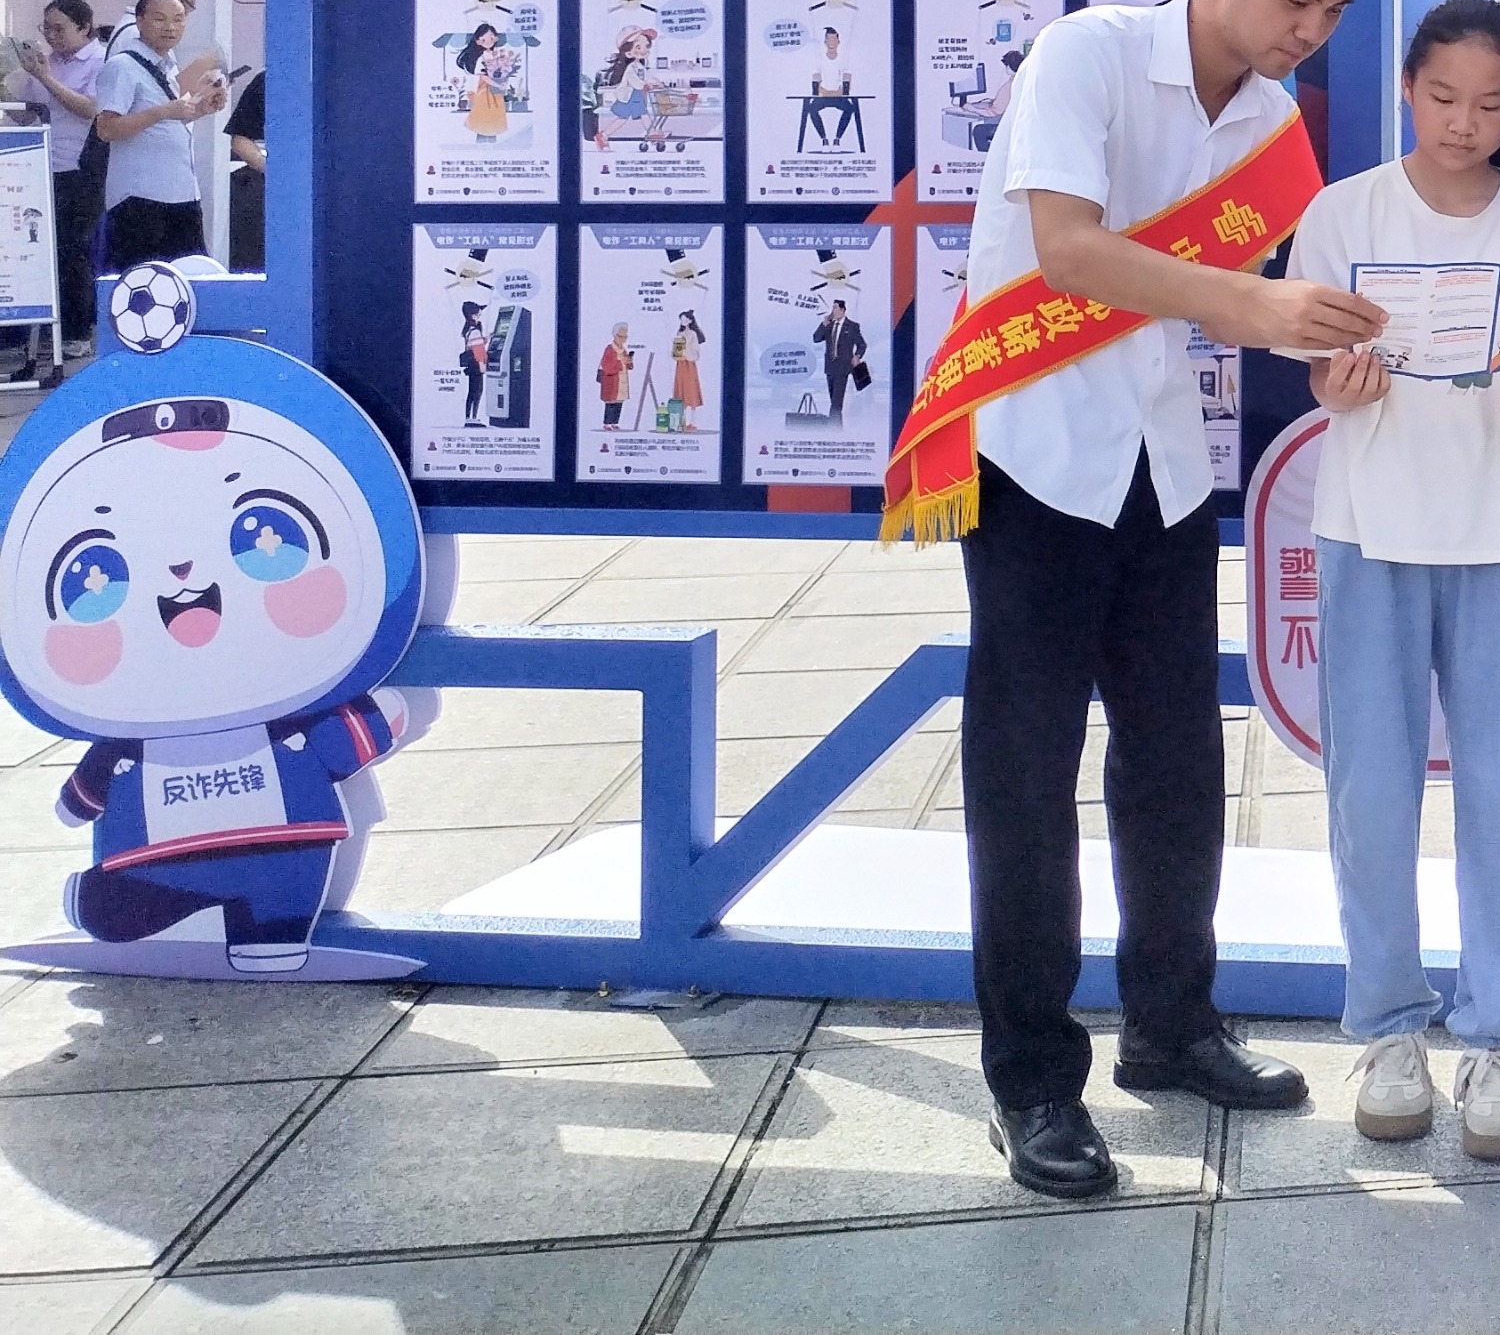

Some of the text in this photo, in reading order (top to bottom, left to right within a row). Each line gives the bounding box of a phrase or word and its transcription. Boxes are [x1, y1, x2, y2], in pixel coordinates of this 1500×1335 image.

[1280, 616, 1318, 670] 不
[161, 763, 265, 807] 反诈先锋
